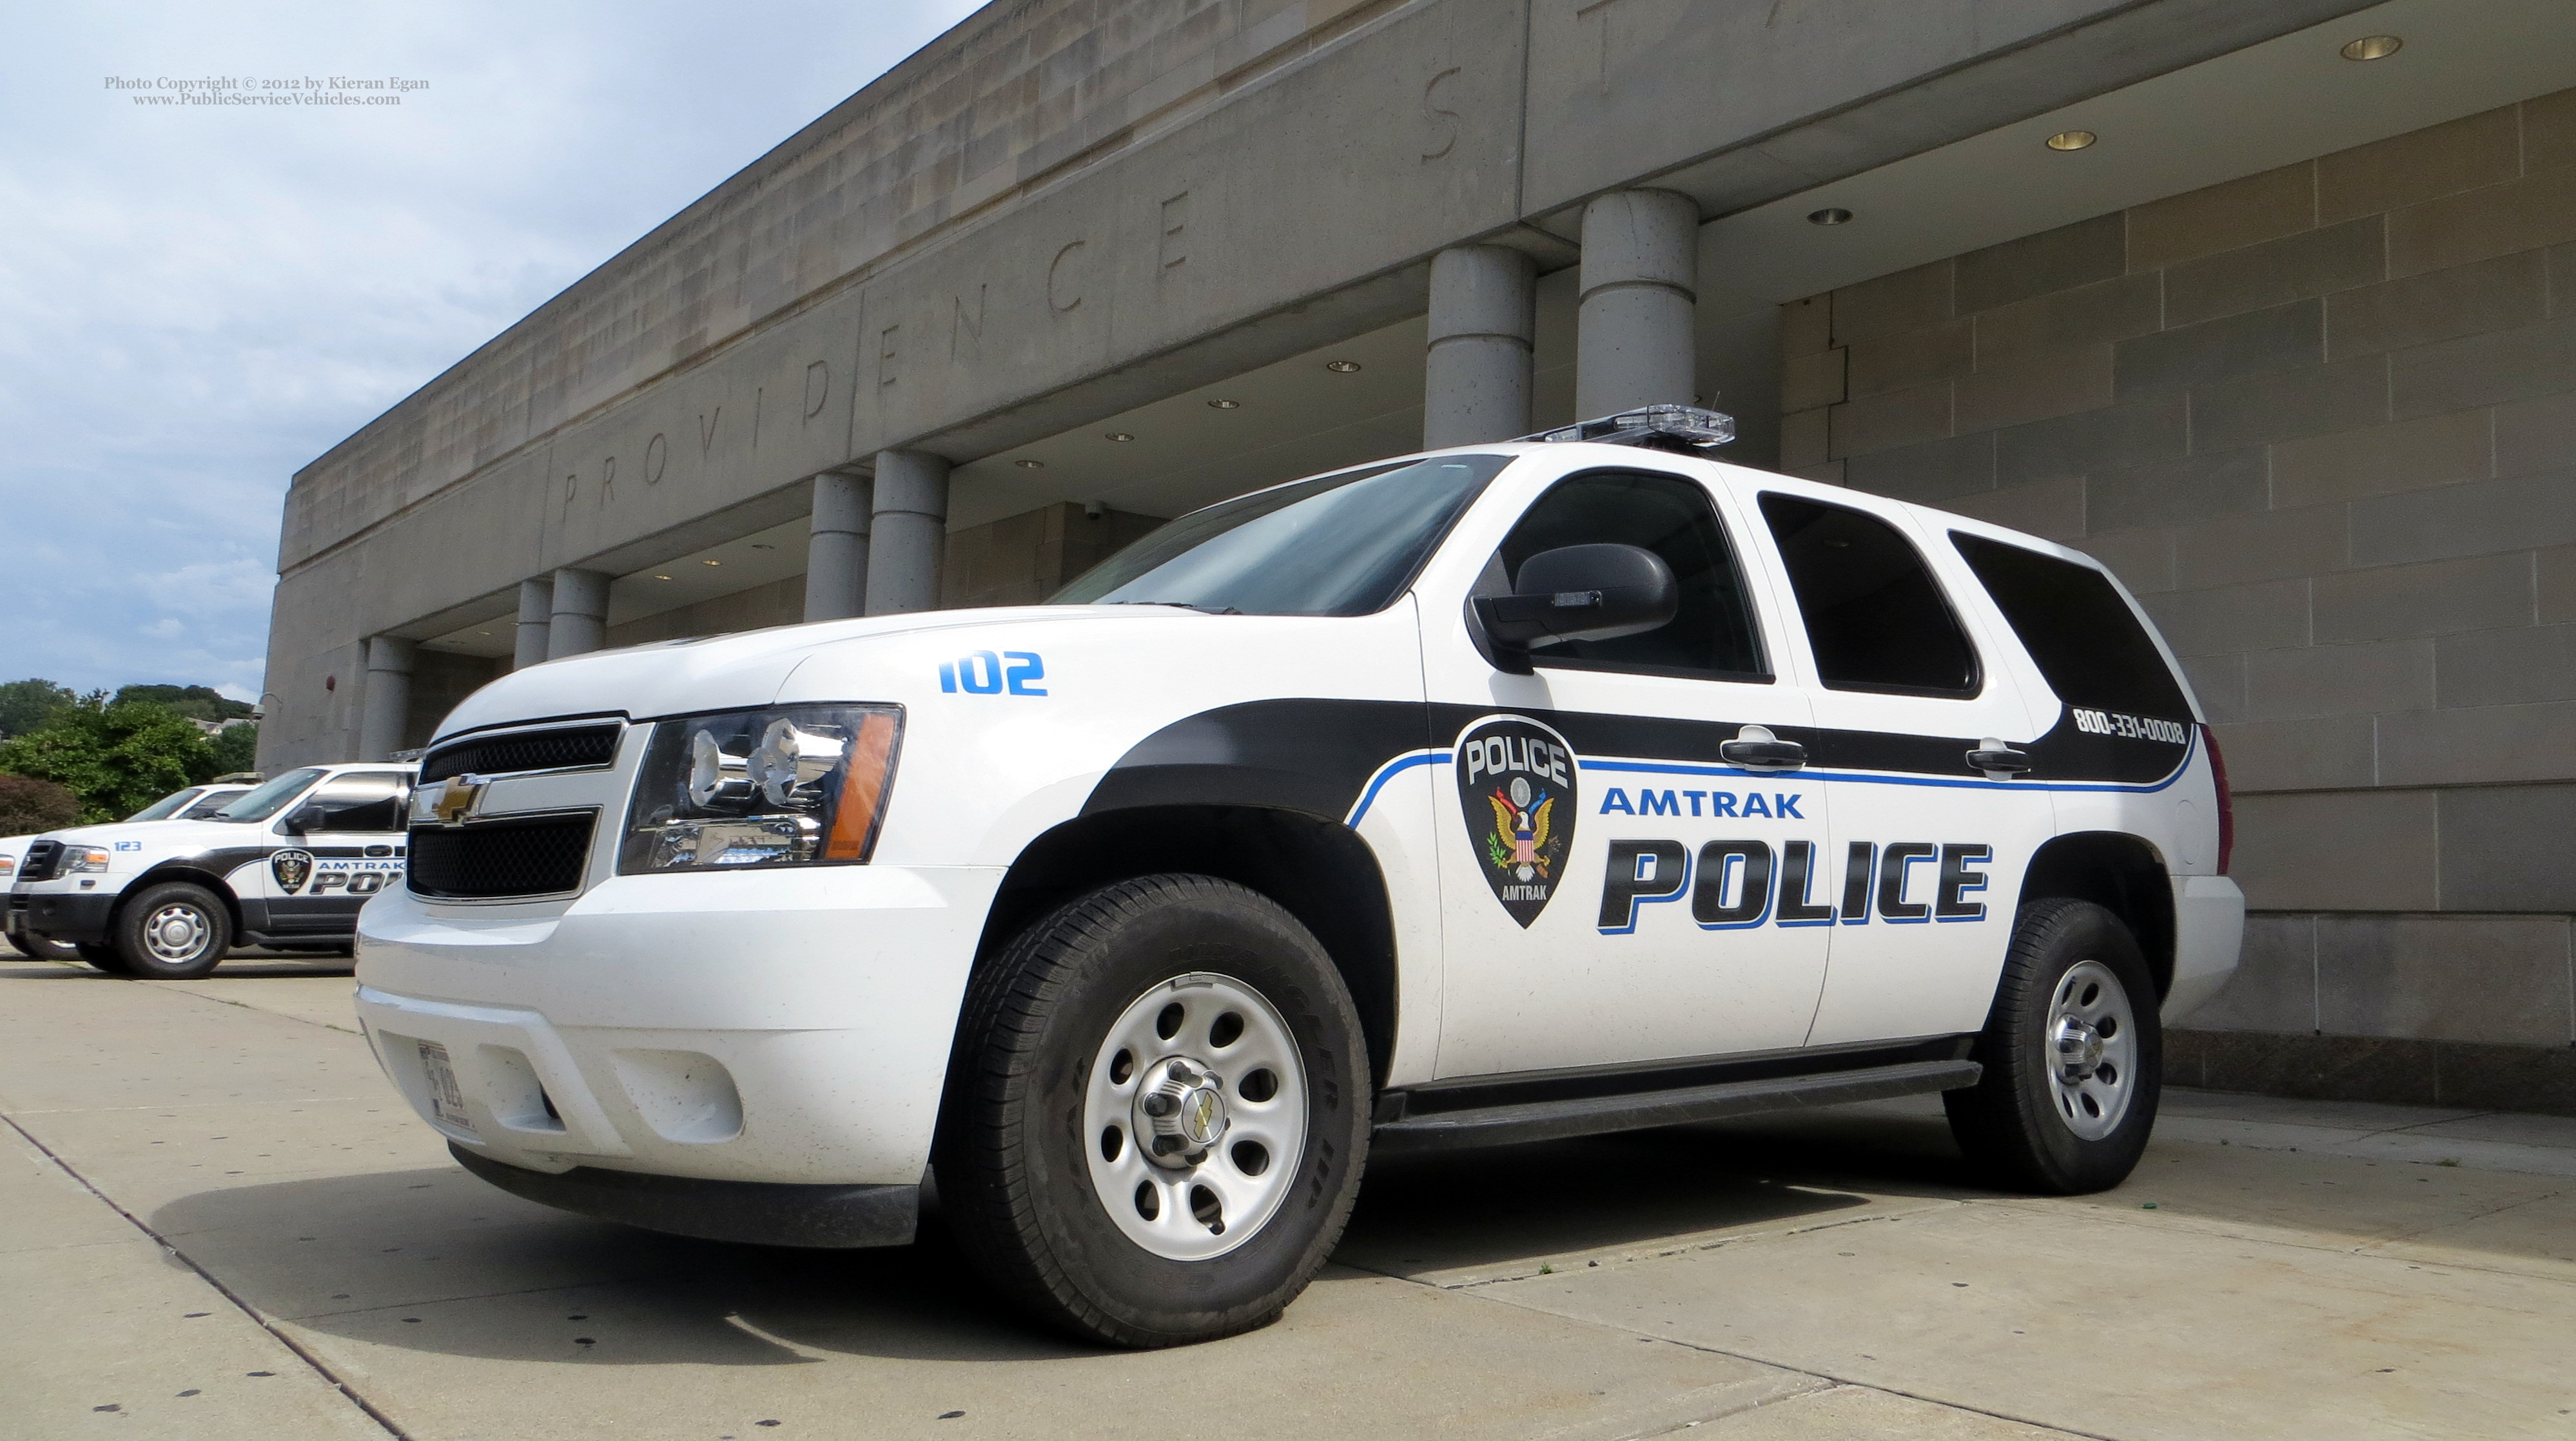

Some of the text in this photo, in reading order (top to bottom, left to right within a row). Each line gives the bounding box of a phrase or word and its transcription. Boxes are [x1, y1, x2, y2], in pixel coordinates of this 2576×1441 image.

[563, 191, 1189, 522] PROVIDENCE
[939, 650, 1048, 697] 102
[2073, 708, 2187, 745] 800-331-0008
[1465, 736, 1569, 789] POLICE
[1599, 788, 1804, 819] AMTRAK
[114, 841, 142, 851] 123
[275, 853, 309, 864] POLICE
[1502, 885, 1547, 901] AMTRAK
[1596, 838, 1993, 936] POLICE
